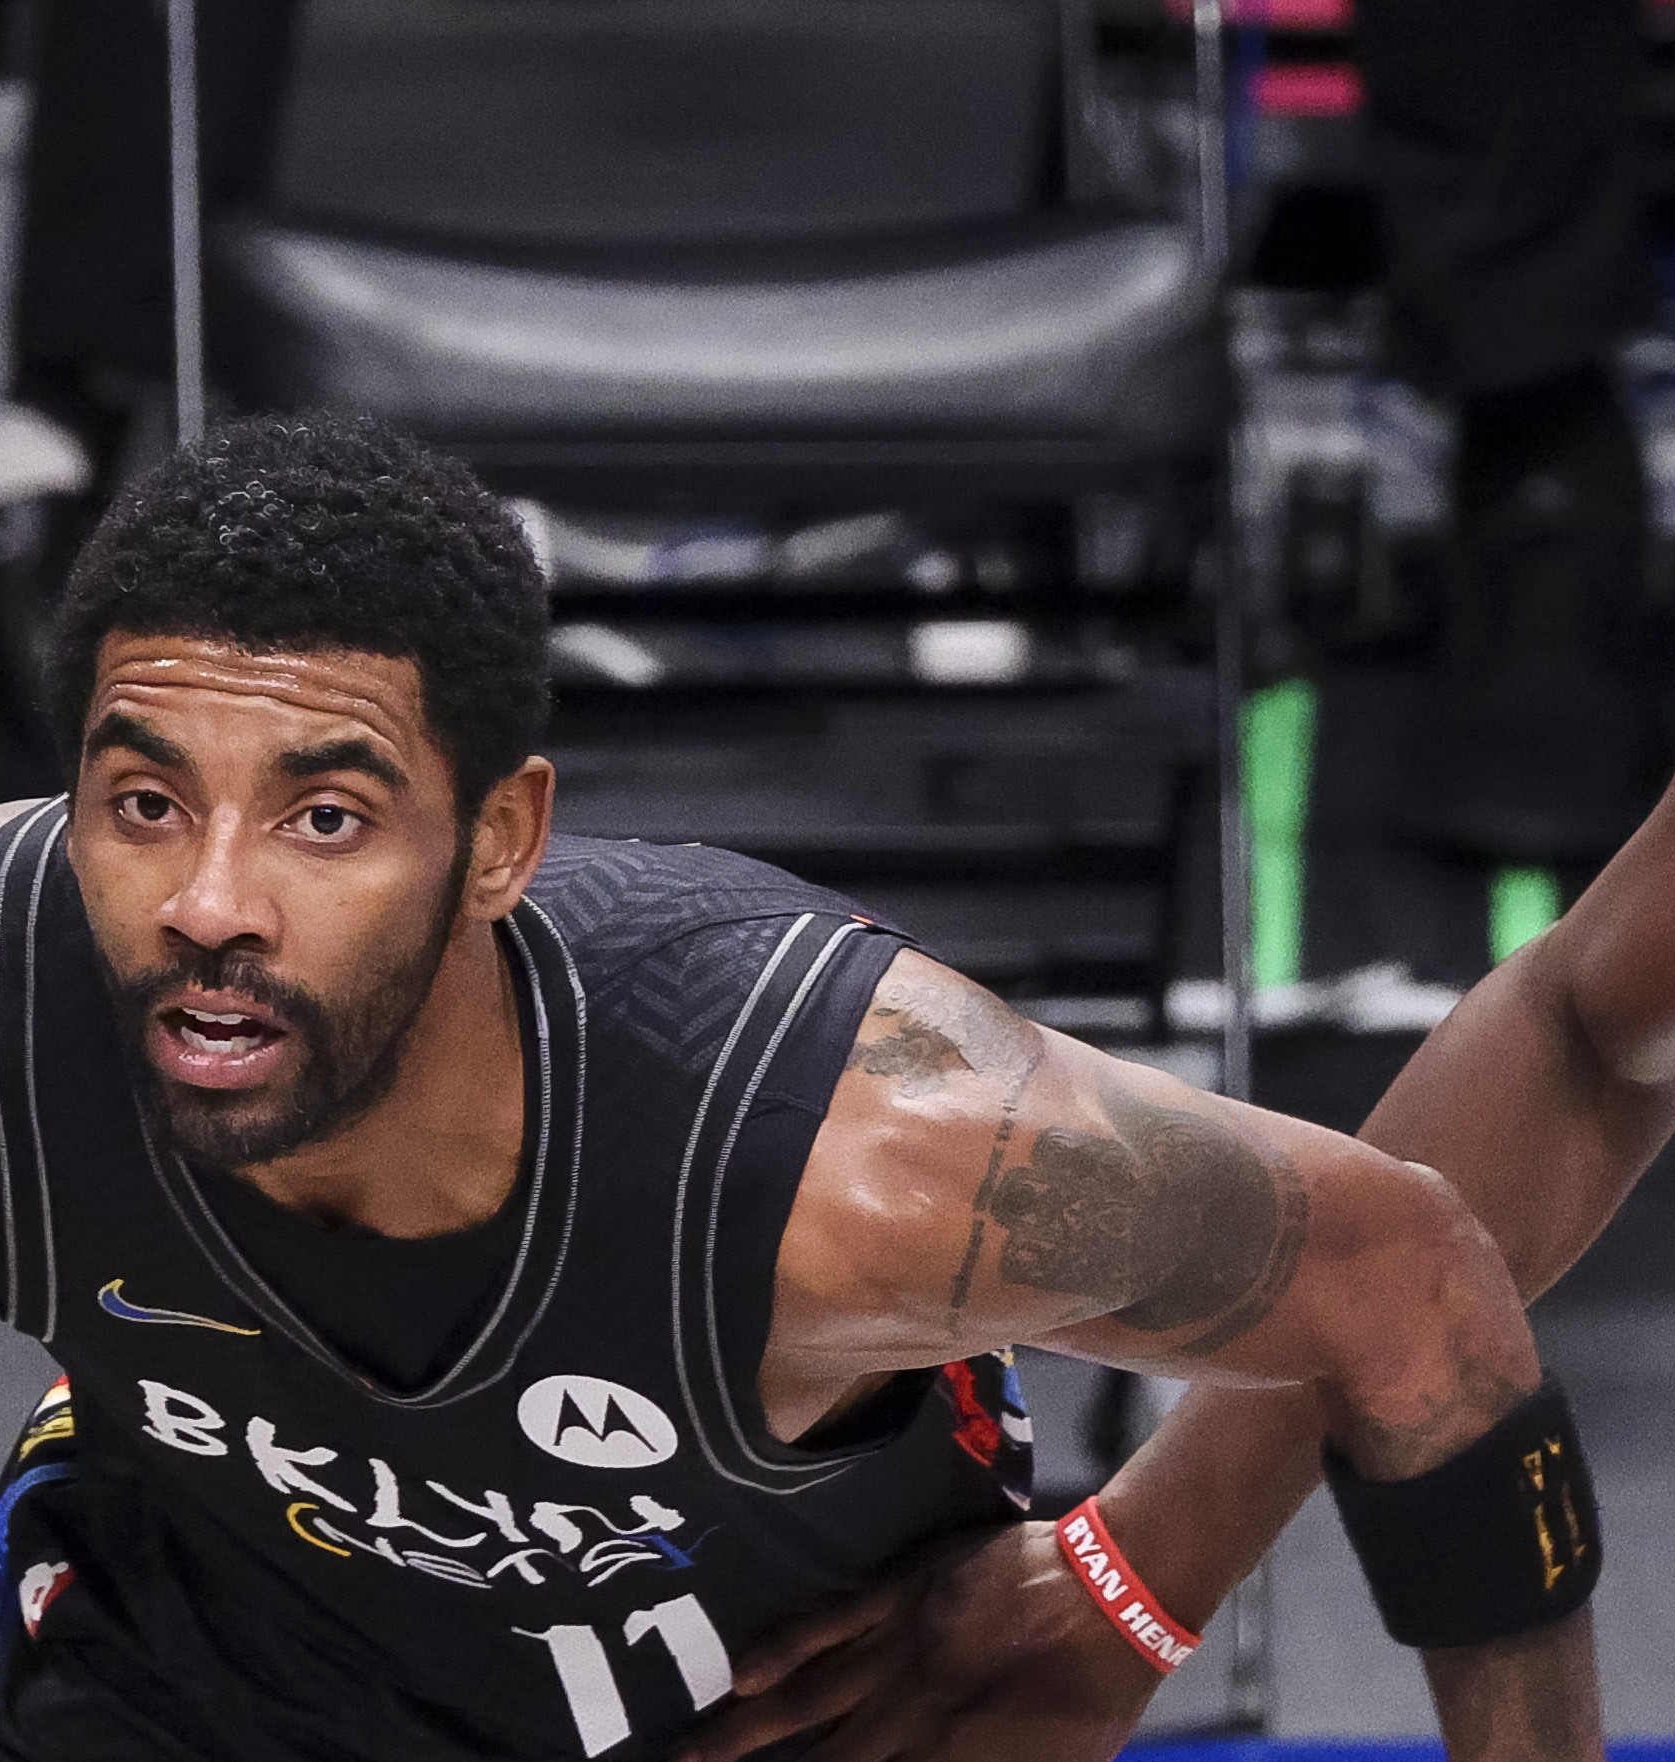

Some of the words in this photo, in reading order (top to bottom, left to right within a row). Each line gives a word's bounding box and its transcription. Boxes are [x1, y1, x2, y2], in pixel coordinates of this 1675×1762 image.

[137, 1378, 686, 1553] BKLYN
[1062, 1515, 1129, 1602] RYAN
[510, 1593, 734, 1760] 11
